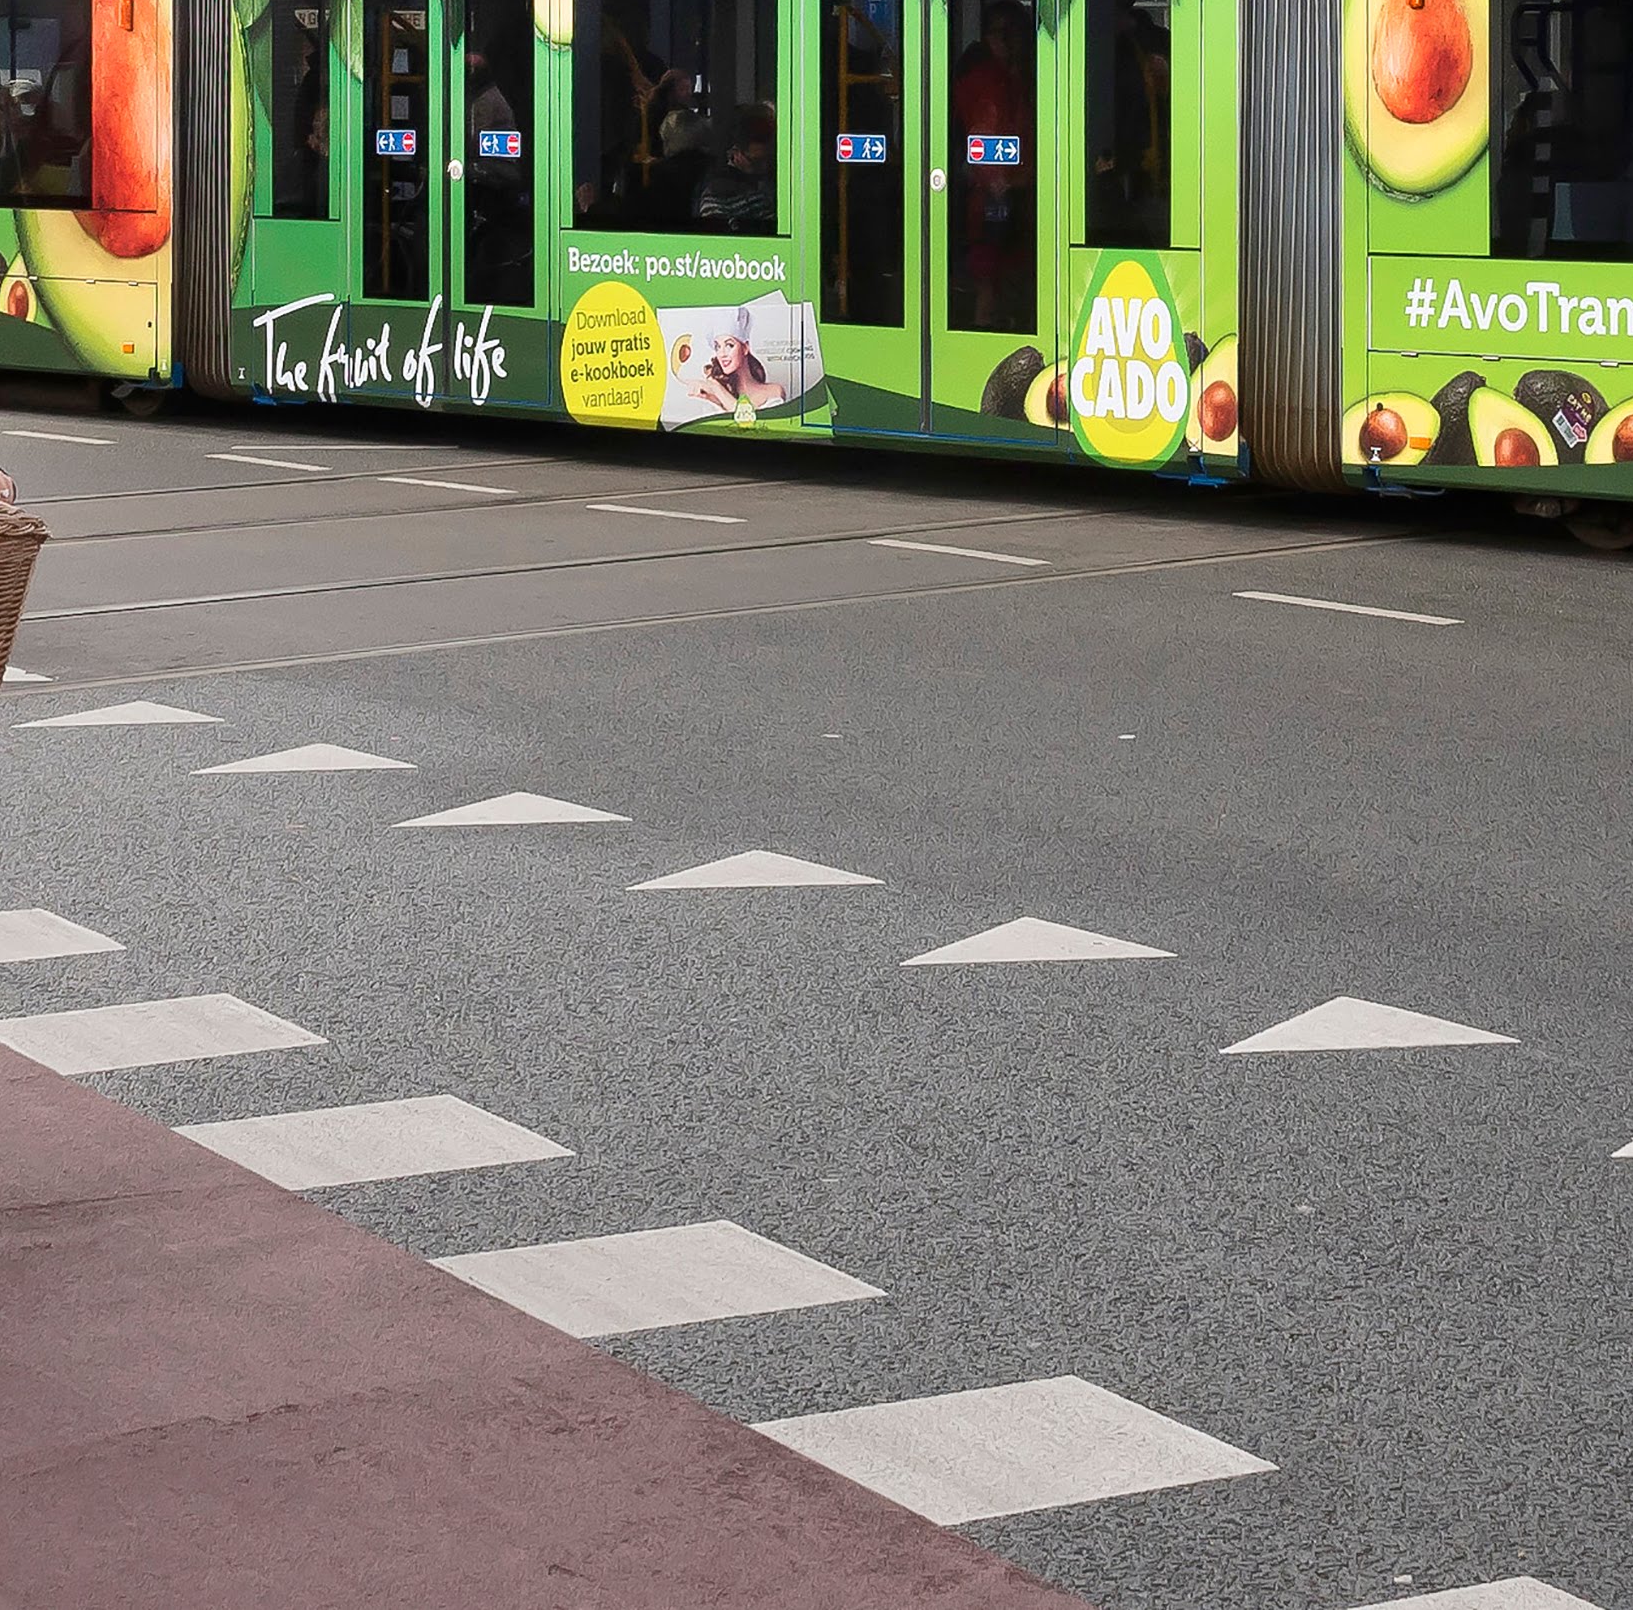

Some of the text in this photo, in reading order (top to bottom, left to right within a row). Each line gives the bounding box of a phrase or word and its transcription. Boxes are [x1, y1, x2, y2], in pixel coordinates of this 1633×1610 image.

[568, 246, 786, 281] Bezoek: po.st/avobook
[576, 306, 646, 331] Download
[1085, 296, 1173, 360] AVO
[253, 292, 508, 408] The fruit of life
[571, 332, 651, 362] jouw gratis
[570, 359, 655, 383] e-kookboek
[582, 386, 644, 411] vandaag!
[1070, 357, 1188, 423] CADO
